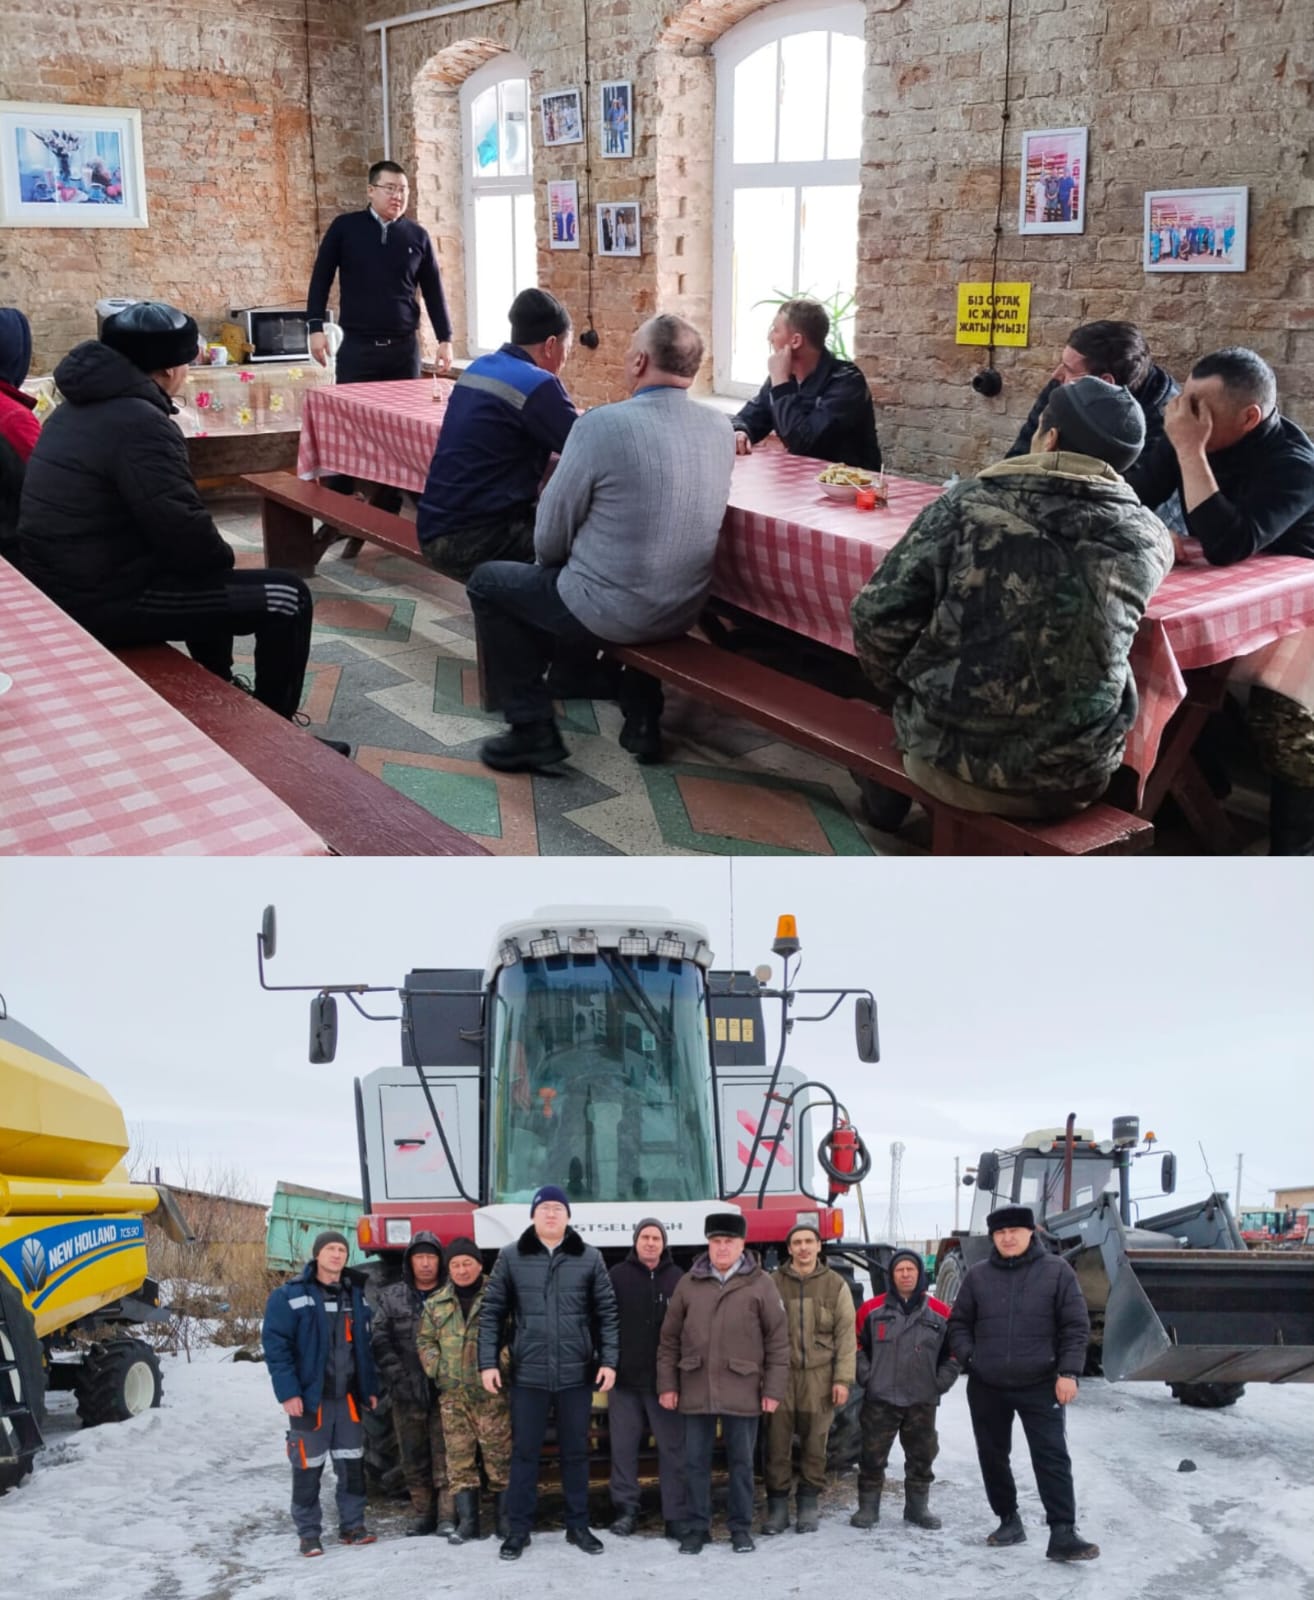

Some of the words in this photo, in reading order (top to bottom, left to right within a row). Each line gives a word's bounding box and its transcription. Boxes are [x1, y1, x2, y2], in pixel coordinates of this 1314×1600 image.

[967, 295, 984, 306] БІЗ
[986, 295, 1020, 307] ОРТАҚ
[968, 309, 979, 319] ІС
[48, 1237, 74, 1271] NEW
[74, 1224, 117, 1256] HOLLAND
